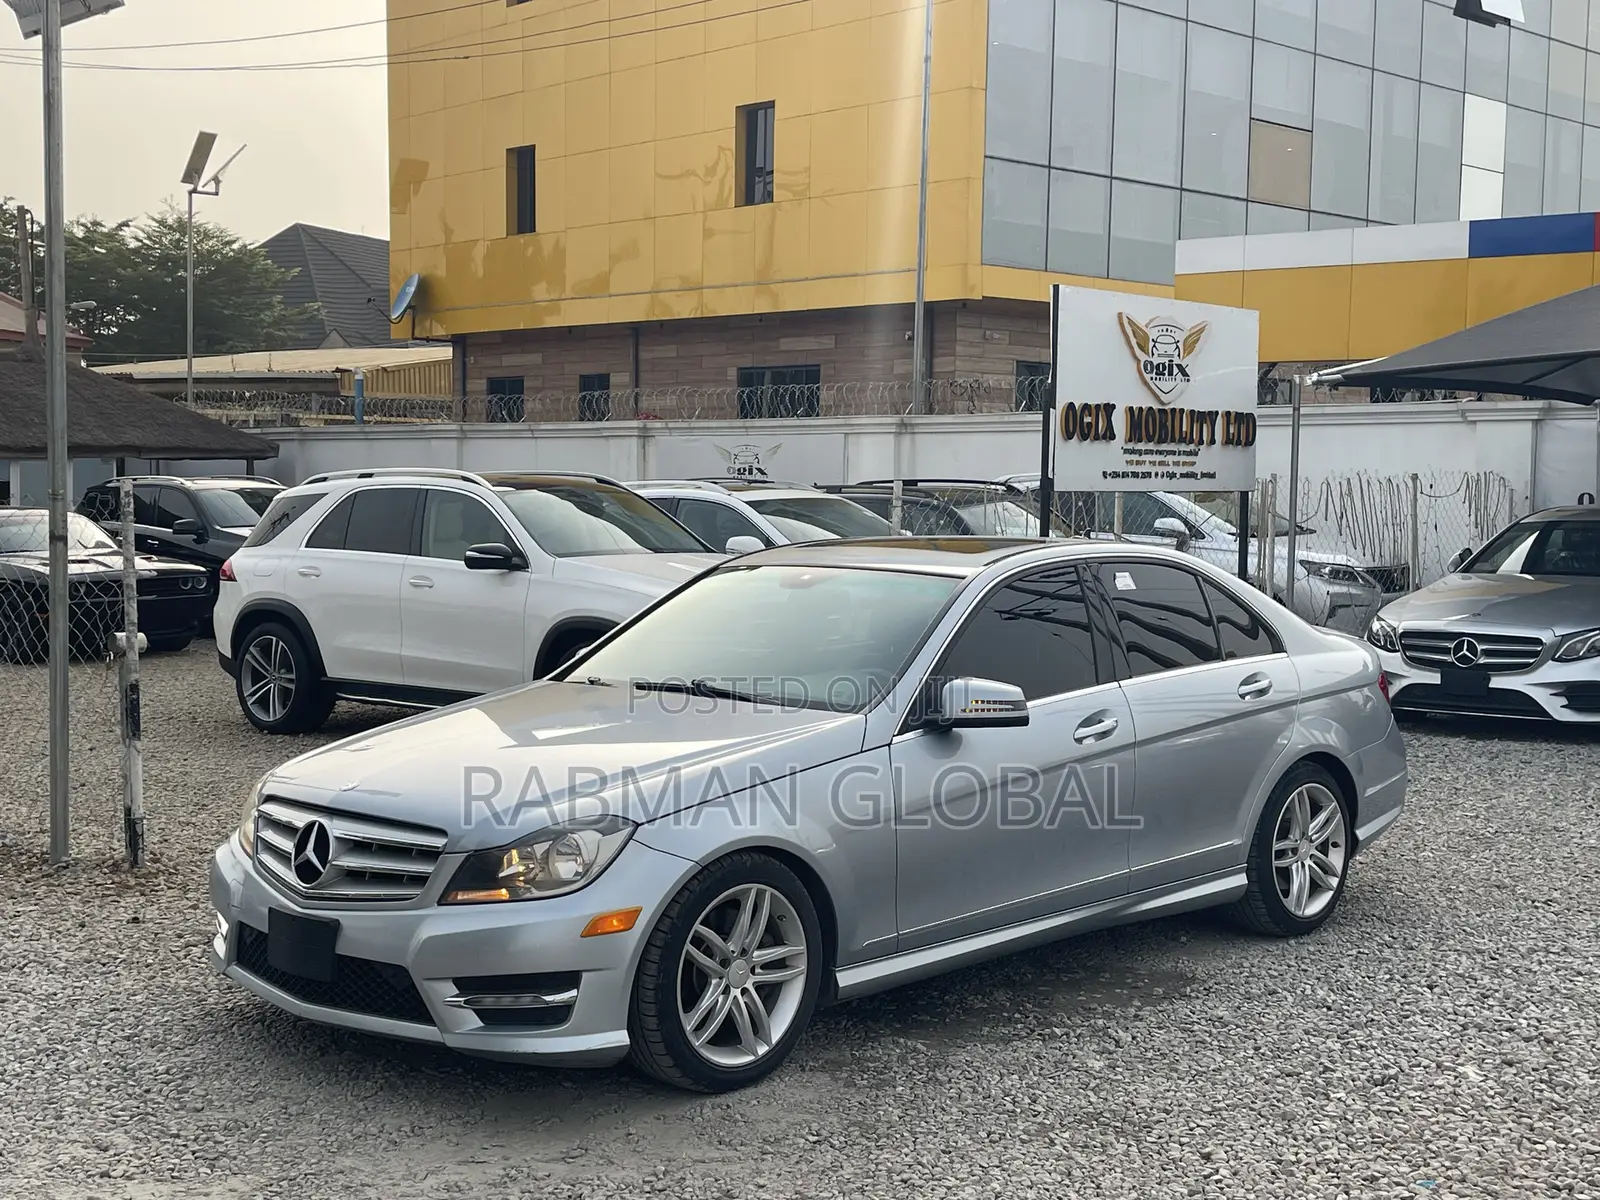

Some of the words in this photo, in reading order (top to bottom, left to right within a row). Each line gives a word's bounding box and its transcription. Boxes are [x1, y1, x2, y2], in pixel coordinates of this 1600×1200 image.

[1060, 401, 1117, 442] OGIX
[1124, 405, 1220, 447] MOBILITY
[1221, 410, 1257, 447] LTD
